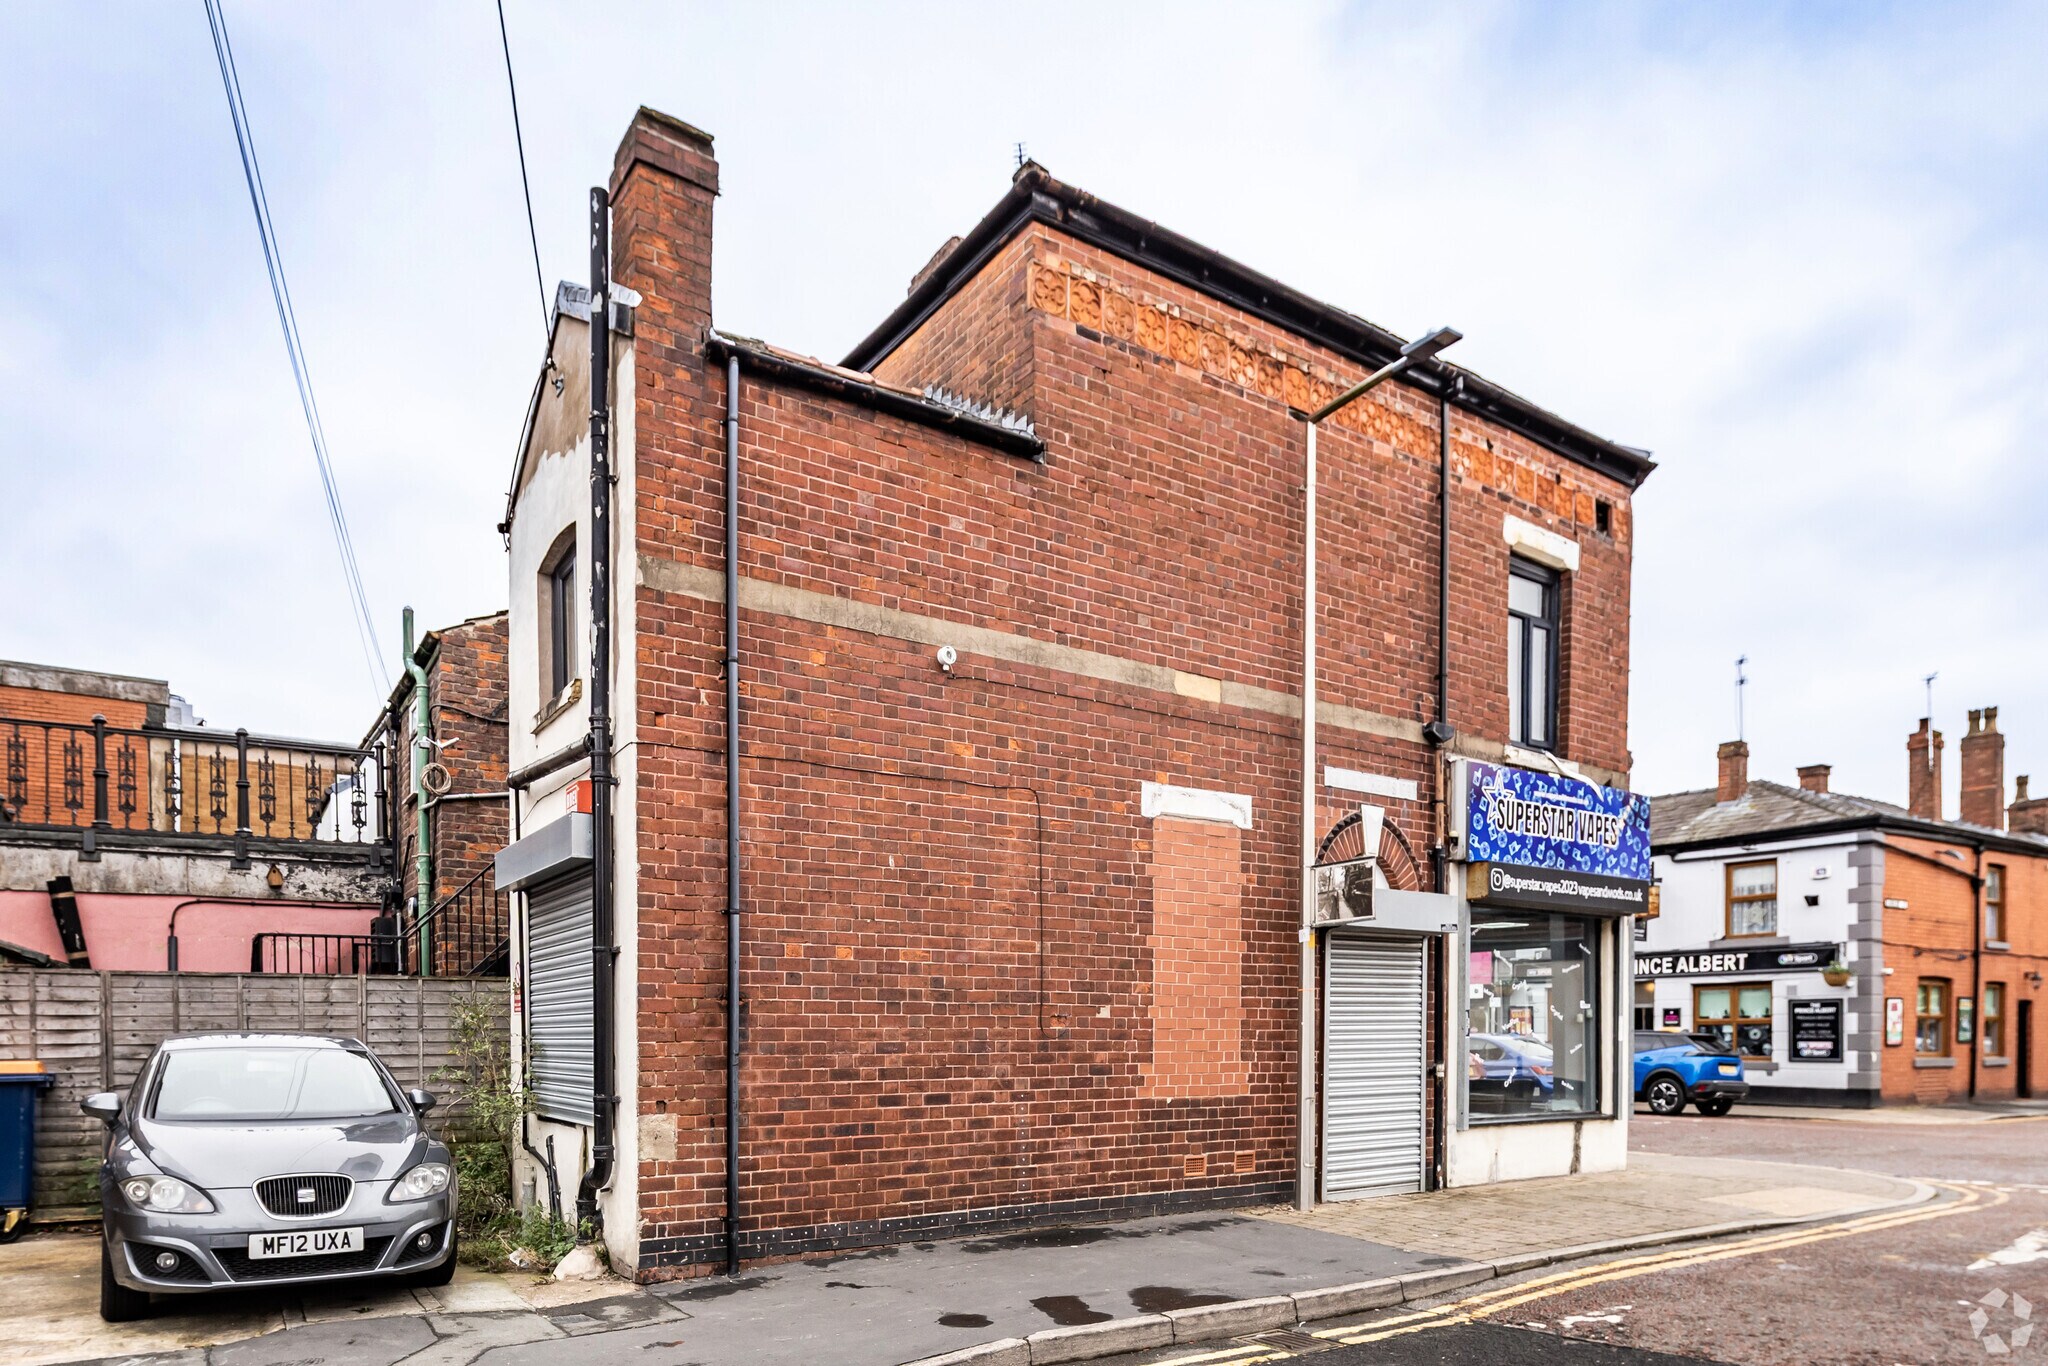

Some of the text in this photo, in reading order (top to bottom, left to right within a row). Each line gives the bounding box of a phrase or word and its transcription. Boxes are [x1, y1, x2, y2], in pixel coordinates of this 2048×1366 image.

[1496, 798, 1618, 846] SUPERSTAR VAPES
[1634, 953, 1748, 975] INCE ALBERT
[263, 1231, 351, 1255] MF12 UXA
